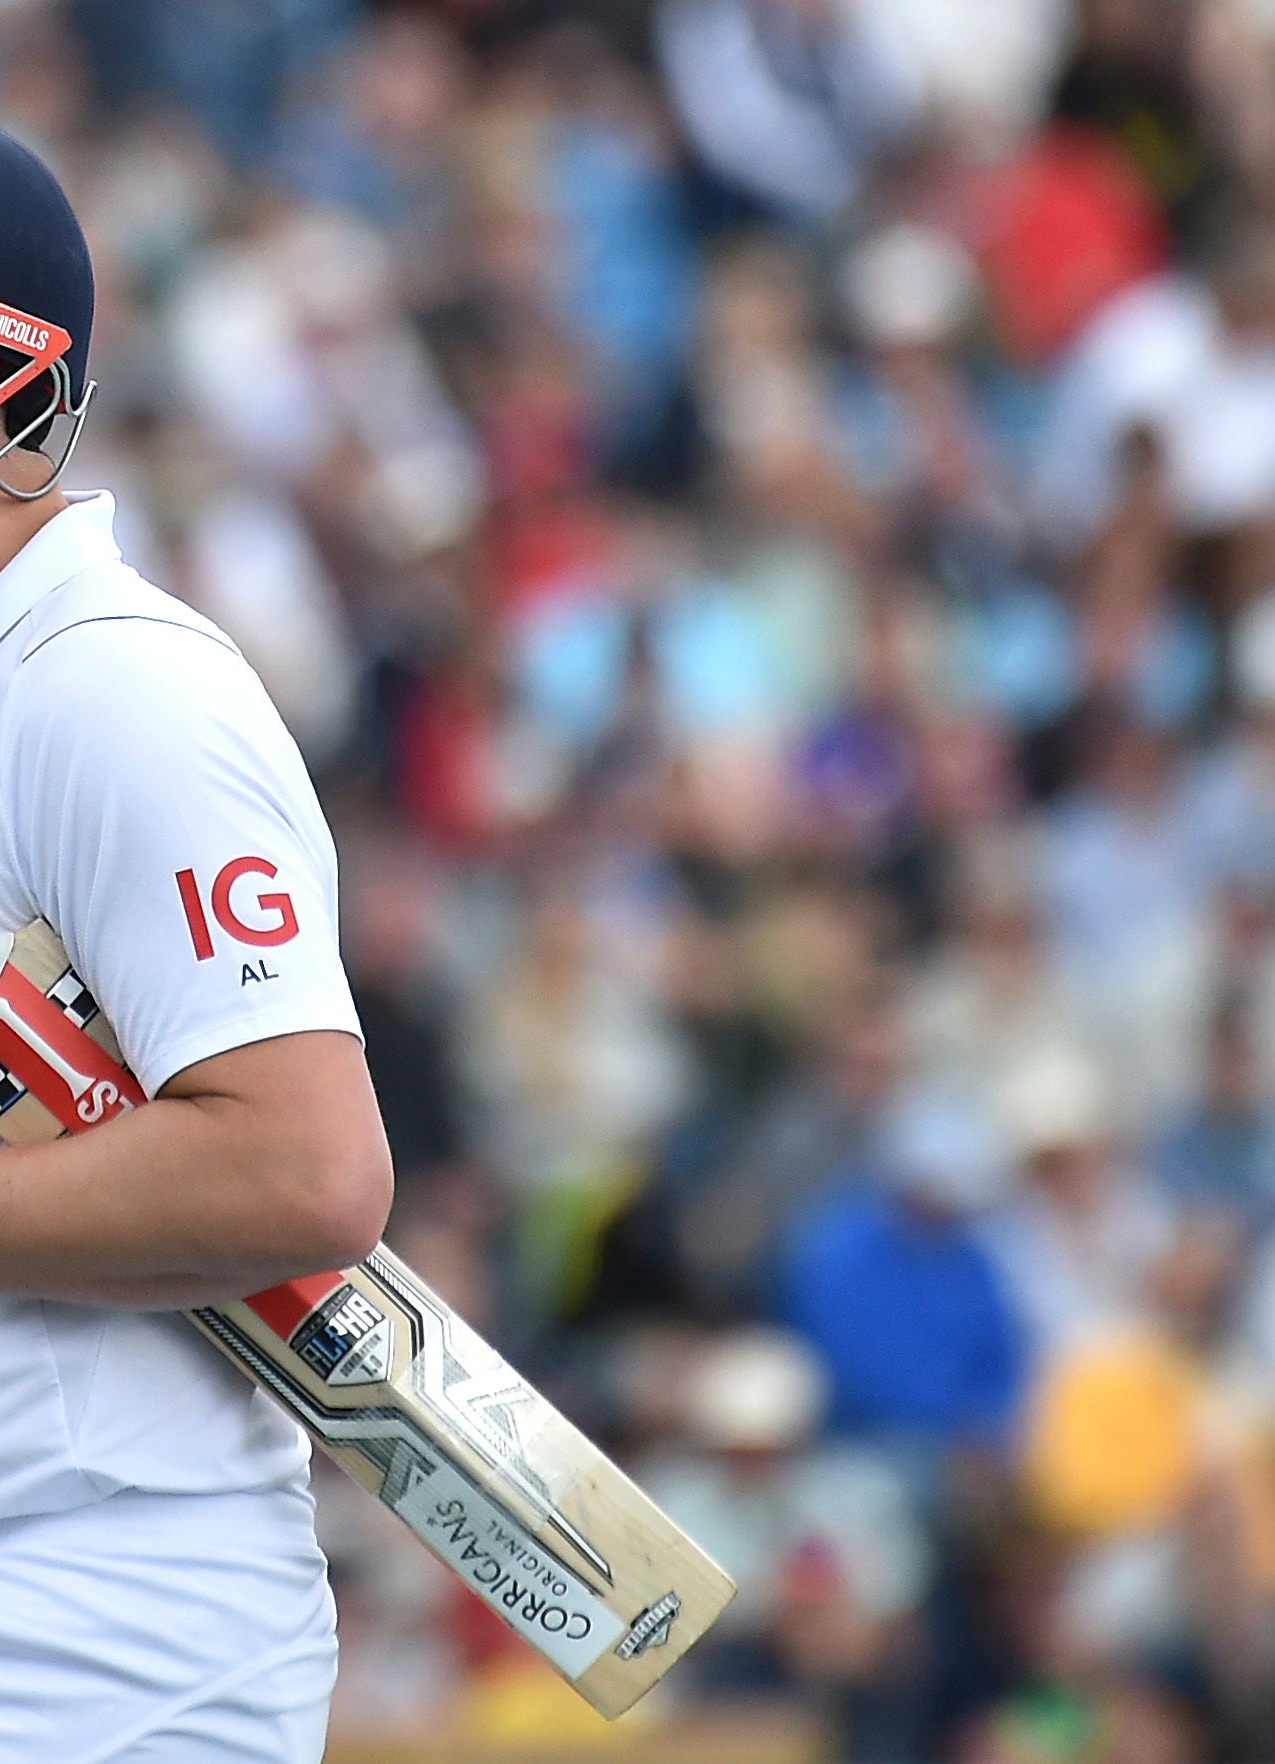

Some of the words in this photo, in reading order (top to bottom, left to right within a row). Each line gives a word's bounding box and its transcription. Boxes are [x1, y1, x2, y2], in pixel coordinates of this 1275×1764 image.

[175, 856, 299, 961] IG
[241, 959, 279, 987] AL
[299, 1291, 383, 1378] ALPHA
[486, 1520, 568, 1597] ORIGINAL
